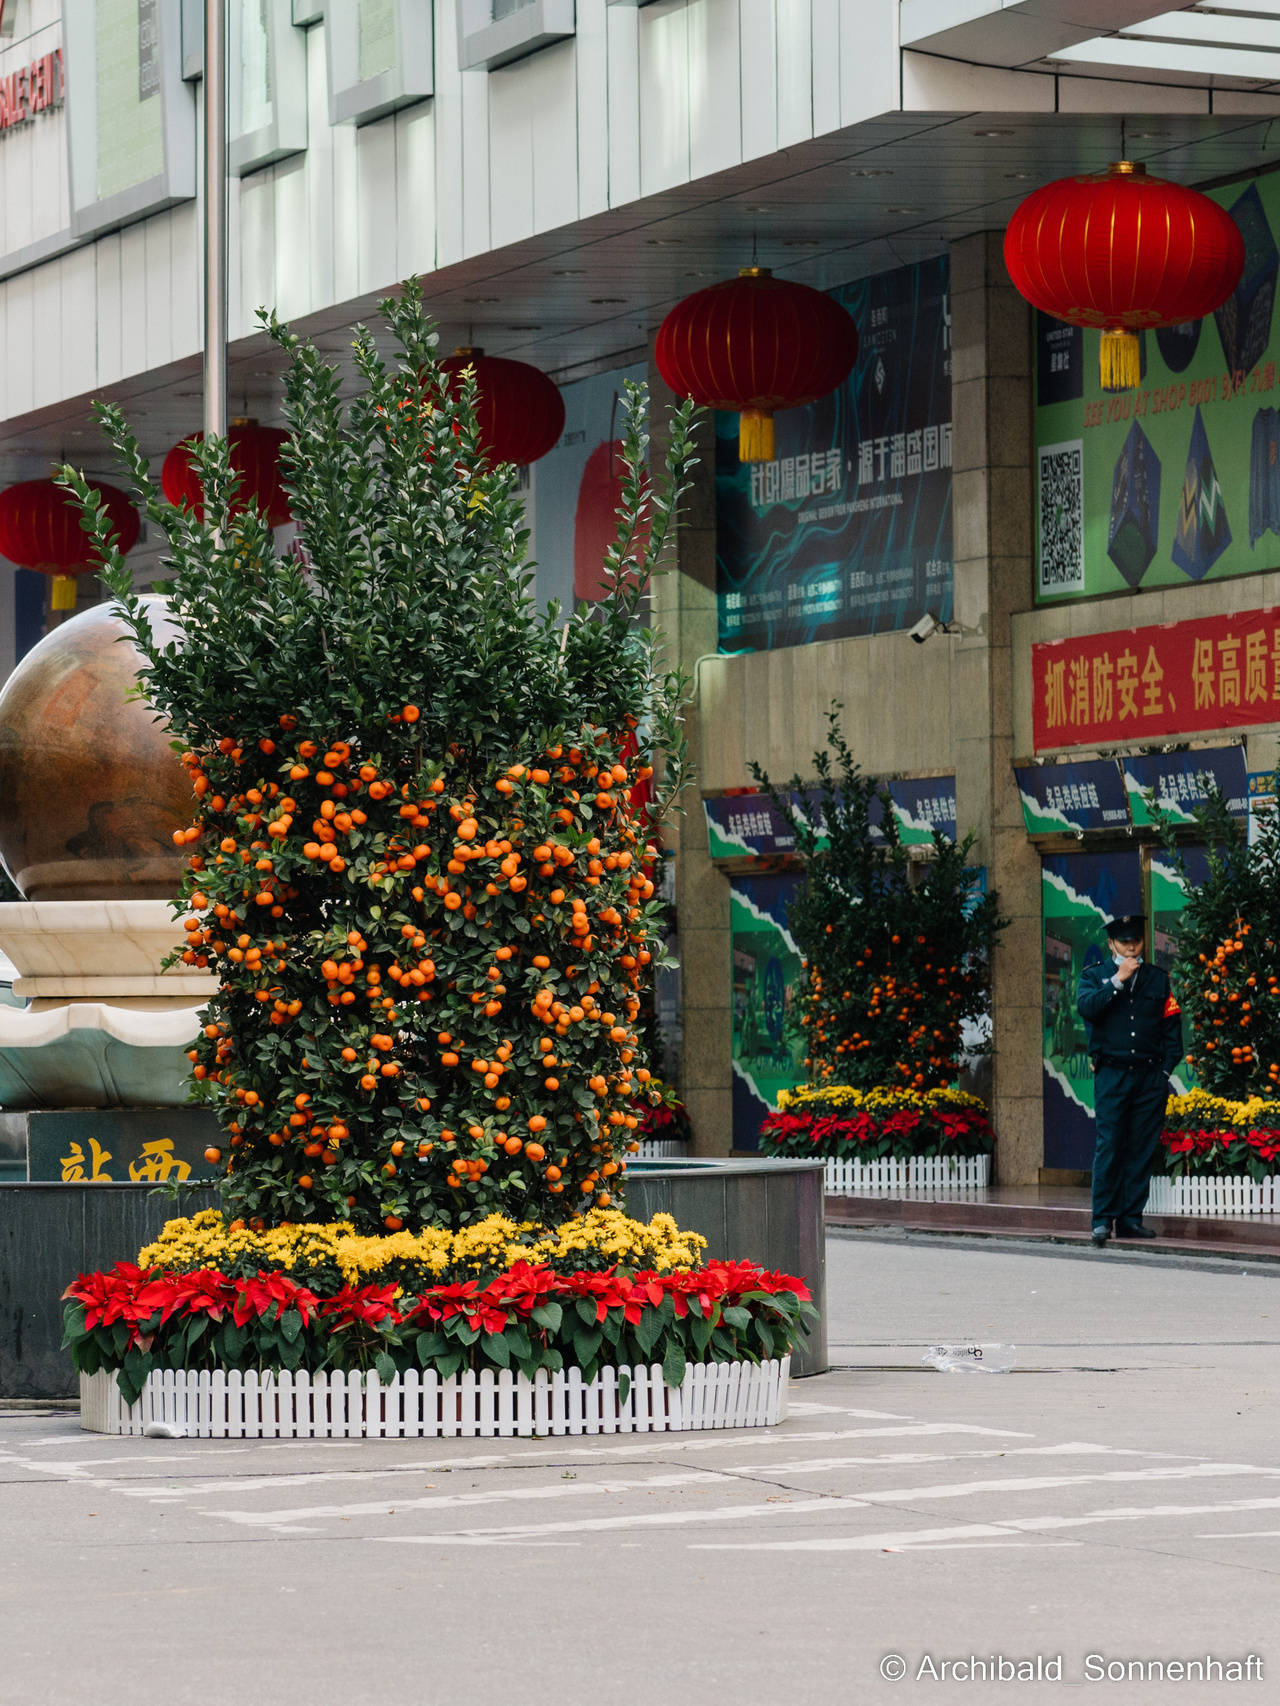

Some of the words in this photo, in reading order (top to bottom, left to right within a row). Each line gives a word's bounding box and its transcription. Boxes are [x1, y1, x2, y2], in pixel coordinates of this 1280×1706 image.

[1083, 403, 1104, 428] SEE
[1107, 397, 1131, 423] YOU
[1133, 393, 1150, 417] AT
[1152, 386, 1186, 414] SHOP
[1045, 782, 1100, 811] 多品类供应链
